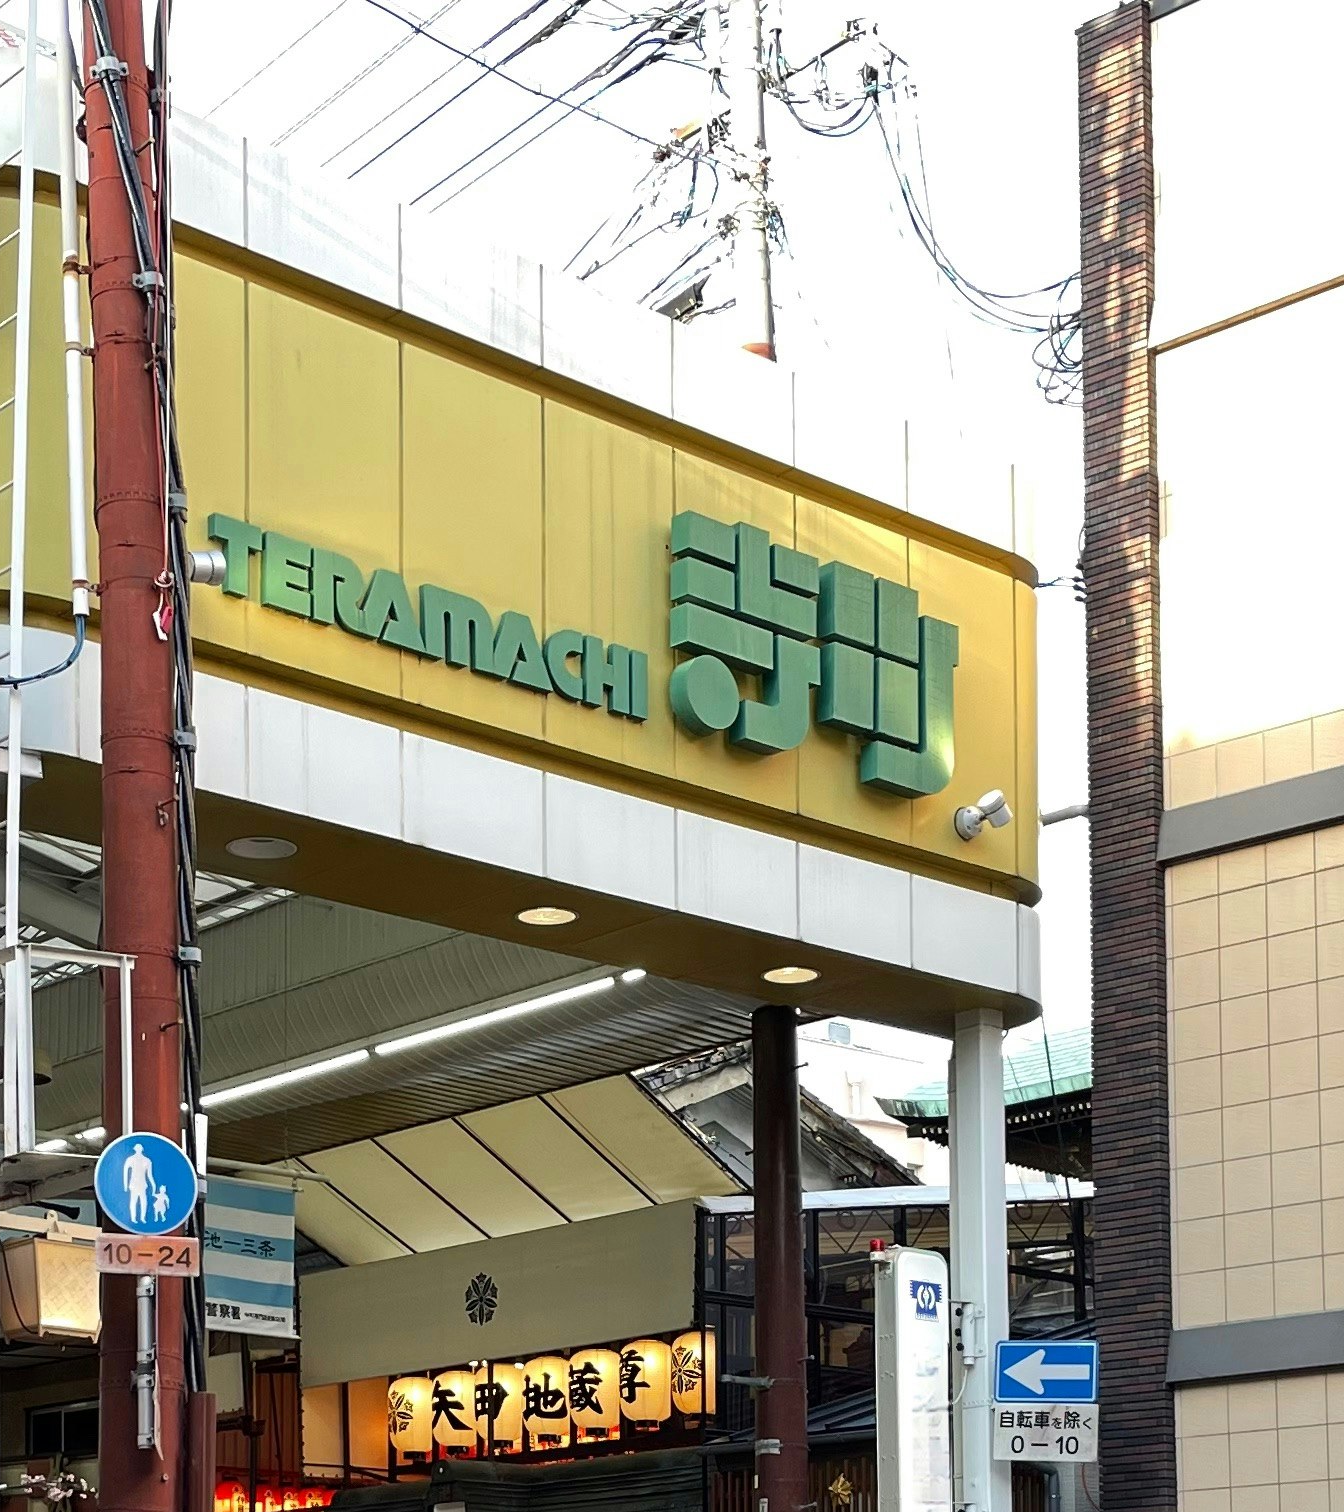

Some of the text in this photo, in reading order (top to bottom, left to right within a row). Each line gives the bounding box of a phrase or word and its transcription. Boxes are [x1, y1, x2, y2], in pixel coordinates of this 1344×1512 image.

[208, 513, 649, 723] TERAMACHI
[1000, 1410, 1093, 1430] 自転車を除く
